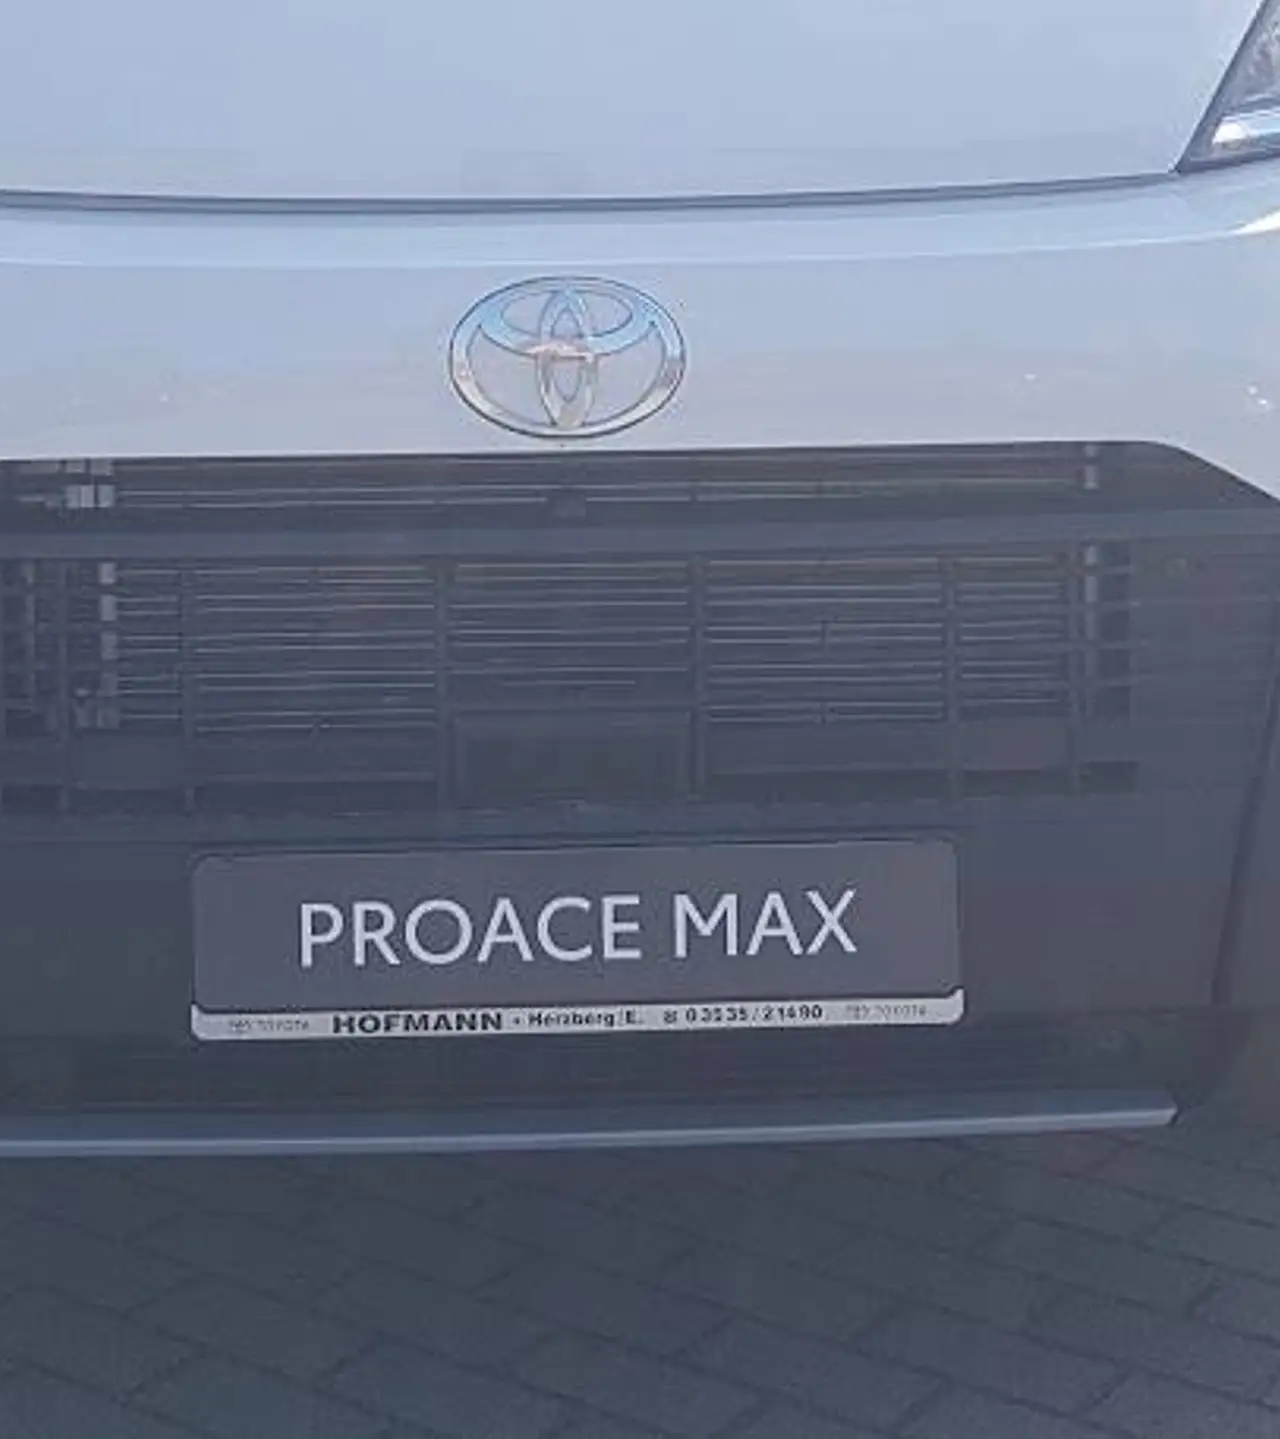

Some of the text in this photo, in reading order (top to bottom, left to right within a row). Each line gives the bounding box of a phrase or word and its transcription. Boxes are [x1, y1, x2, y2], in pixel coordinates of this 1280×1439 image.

[298, 889, 859, 969] PROACE MAX
[332, 1012, 502, 1034] HOFMANN
